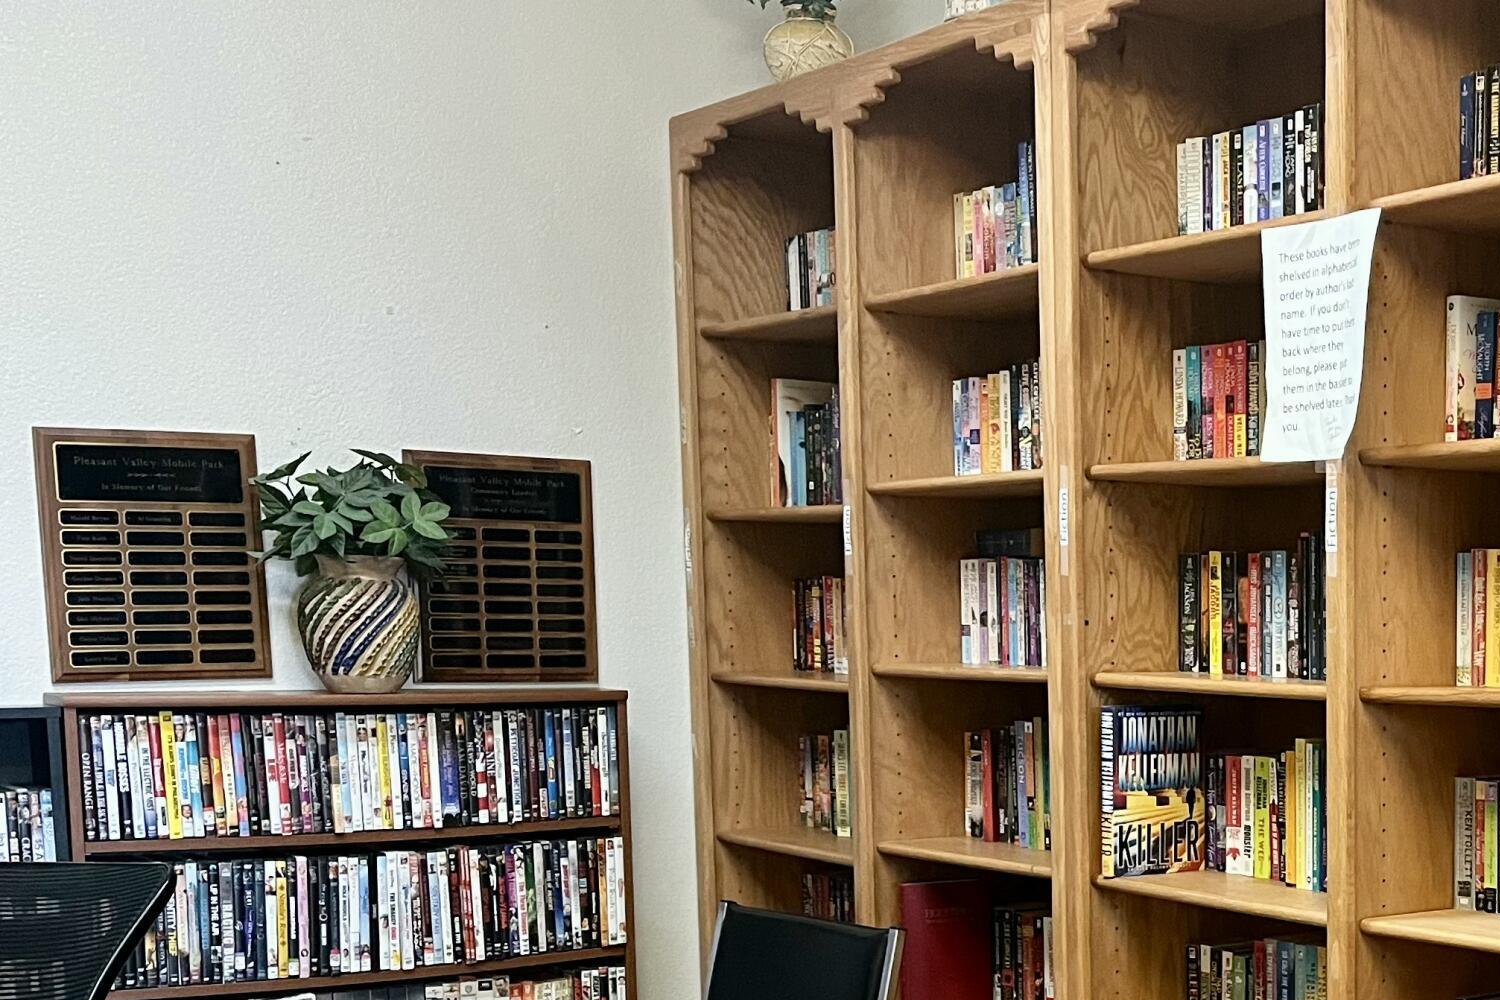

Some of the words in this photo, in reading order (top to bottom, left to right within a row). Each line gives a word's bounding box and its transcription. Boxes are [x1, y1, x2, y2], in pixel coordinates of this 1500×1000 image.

[1279, 252, 1304, 264] These
[1306, 247, 1328, 260] books
[1330, 243, 1348, 255] have
[1279, 270, 1311, 282] shelved
[1313, 269, 1320, 278] in
[1280, 290, 1303, 301] order
[1305, 288, 1314, 300] by
[1316, 283, 1345, 296] author's
[1317, 304, 1331, 316] you
[1282, 326, 1301, 339] have
[1304, 324, 1320, 337] time
[1322, 322, 1330, 334] to
[1282, 344, 1302, 357] back
[1304, 342, 1326, 355] where
[1328, 340, 1344, 352] they
[1175, 367, 1184, 388] LINDA
[1314, 362, 1337, 374] please
[1283, 384, 1304, 395] them
[1306, 384, 1314, 392] in
[1316, 381, 1327, 392] the
[1175, 392, 1184, 425] HOWARD
[1283, 402, 1293, 414] be
[1295, 399, 1324, 413] shelved
[73, 456, 117, 467] Pleasant
[122, 457, 157, 469] Valley
[161, 458, 197, 468] Mobile
[1327, 491, 1337, 547] Fiction
[1101, 712, 1113, 756] JONATHAN
[1123, 715, 1196, 750] JONATHAN
[1016, 735, 1025, 784] TUCSON
[1118, 752, 1199, 791] KELLERMAN
[1101, 758, 1113, 813] KELLERMAN
[1463, 809, 1472, 829] KEN
[1101, 815, 1111, 856] KILLER
[1117, 818, 1198, 869] KILLER
[1463, 832, 1472, 880] FOLLETT
